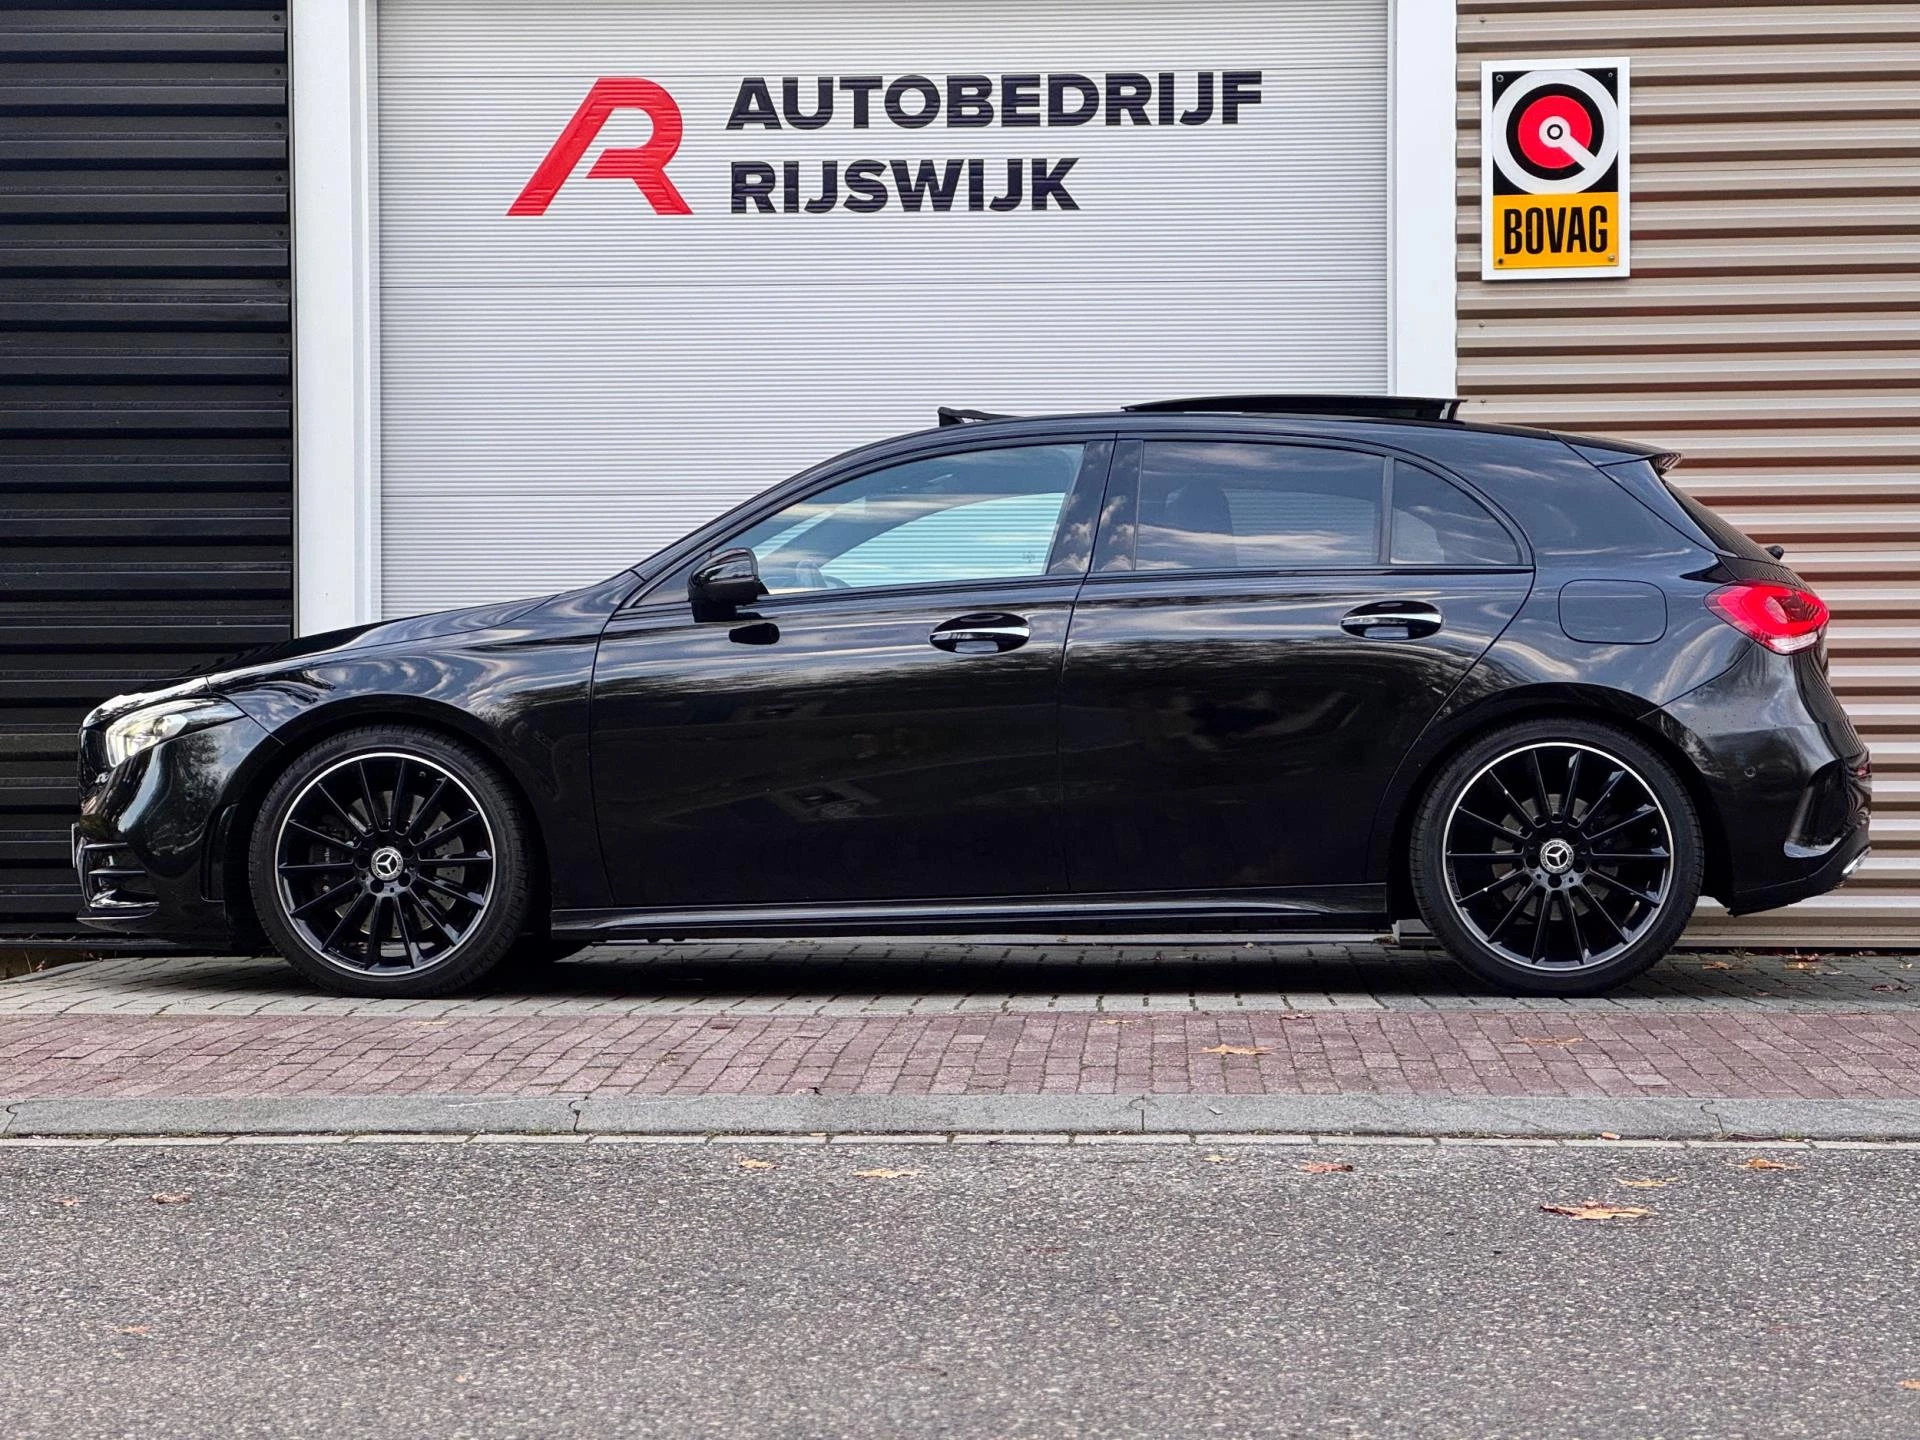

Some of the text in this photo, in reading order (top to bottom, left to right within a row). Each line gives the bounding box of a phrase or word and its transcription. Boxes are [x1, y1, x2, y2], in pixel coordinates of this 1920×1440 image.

[725, 70, 1262, 131] AUTOBEDRIJF
[730, 157, 1080, 214] RIJSWIJK
[1503, 205, 1608, 255] BOVAG
